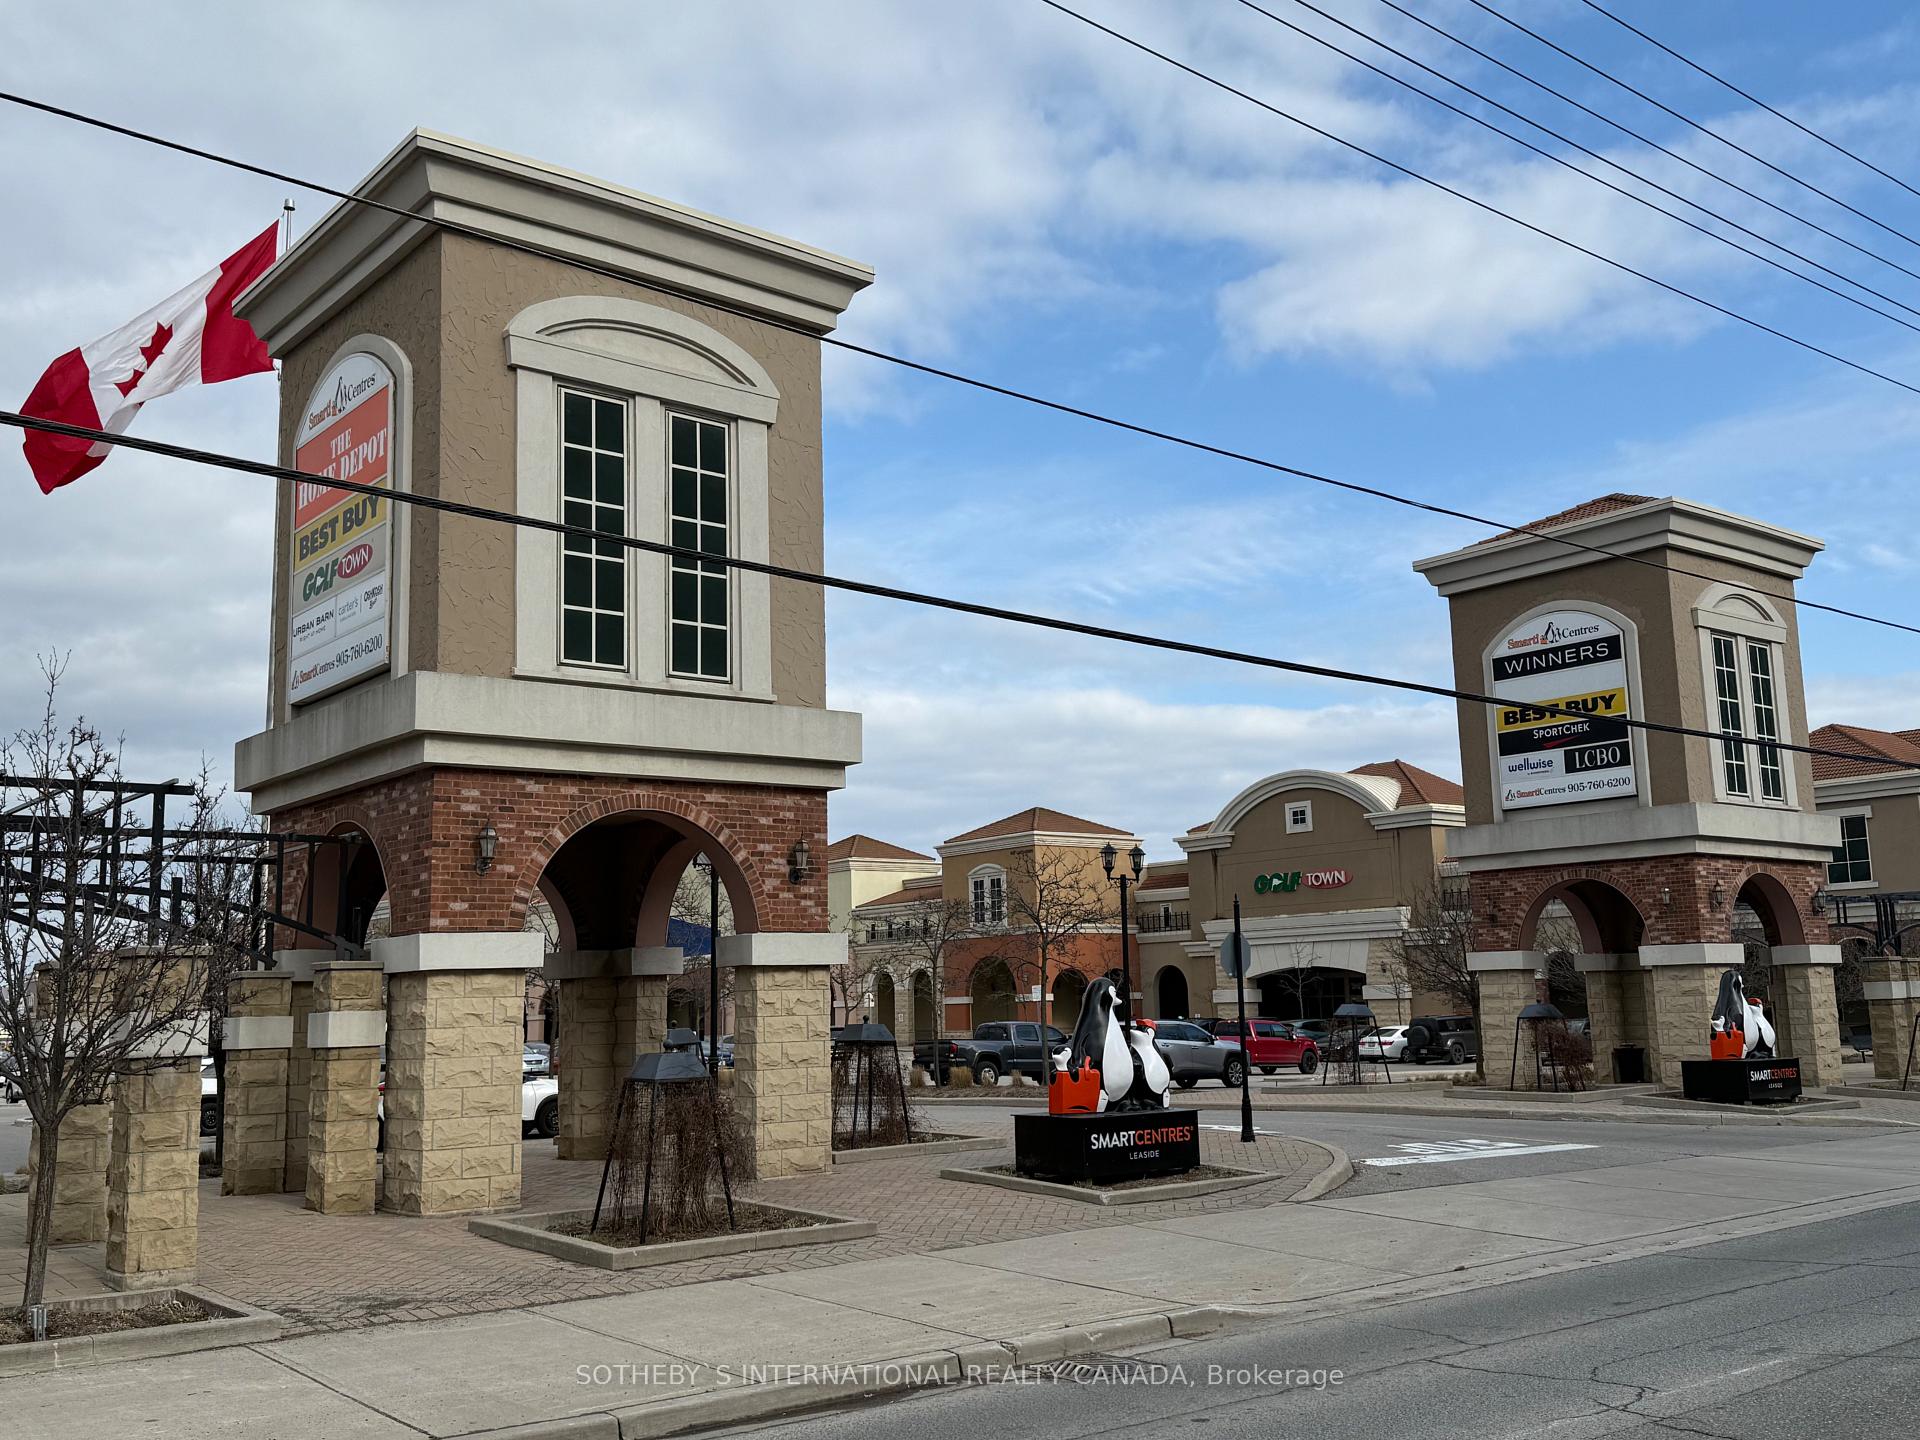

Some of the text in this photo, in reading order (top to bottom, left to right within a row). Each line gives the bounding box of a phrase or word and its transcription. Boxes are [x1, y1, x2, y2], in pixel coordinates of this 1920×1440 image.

[348, 373, 377, 402] Centres
[330, 429, 352, 459] THE
[340, 429, 387, 482] DEPOT
[299, 495, 379, 562] BEST BUY
[302, 545, 369, 602] GOLF TOWN
[316, 609, 335, 627] BARN
[1561, 624, 1600, 639] Centres
[336, 633, 383, 668] 905-760-6200
[1504, 642, 1610, 674] WINNERS
[1504, 693, 1617, 726] BEST BUY
[1508, 757, 1554, 773] wellwise
[1575, 746, 1620, 769] LCBO
[1567, 776, 1631, 793] 905-760-6200
[1253, 870, 1346, 894] GOLF TOWN
[1750, 1067, 1796, 1081] SMARTCENTRES
[1090, 1126, 1191, 1150] SMARTCENTRES
[1129, 1149, 1160, 1160] LEASIDE
